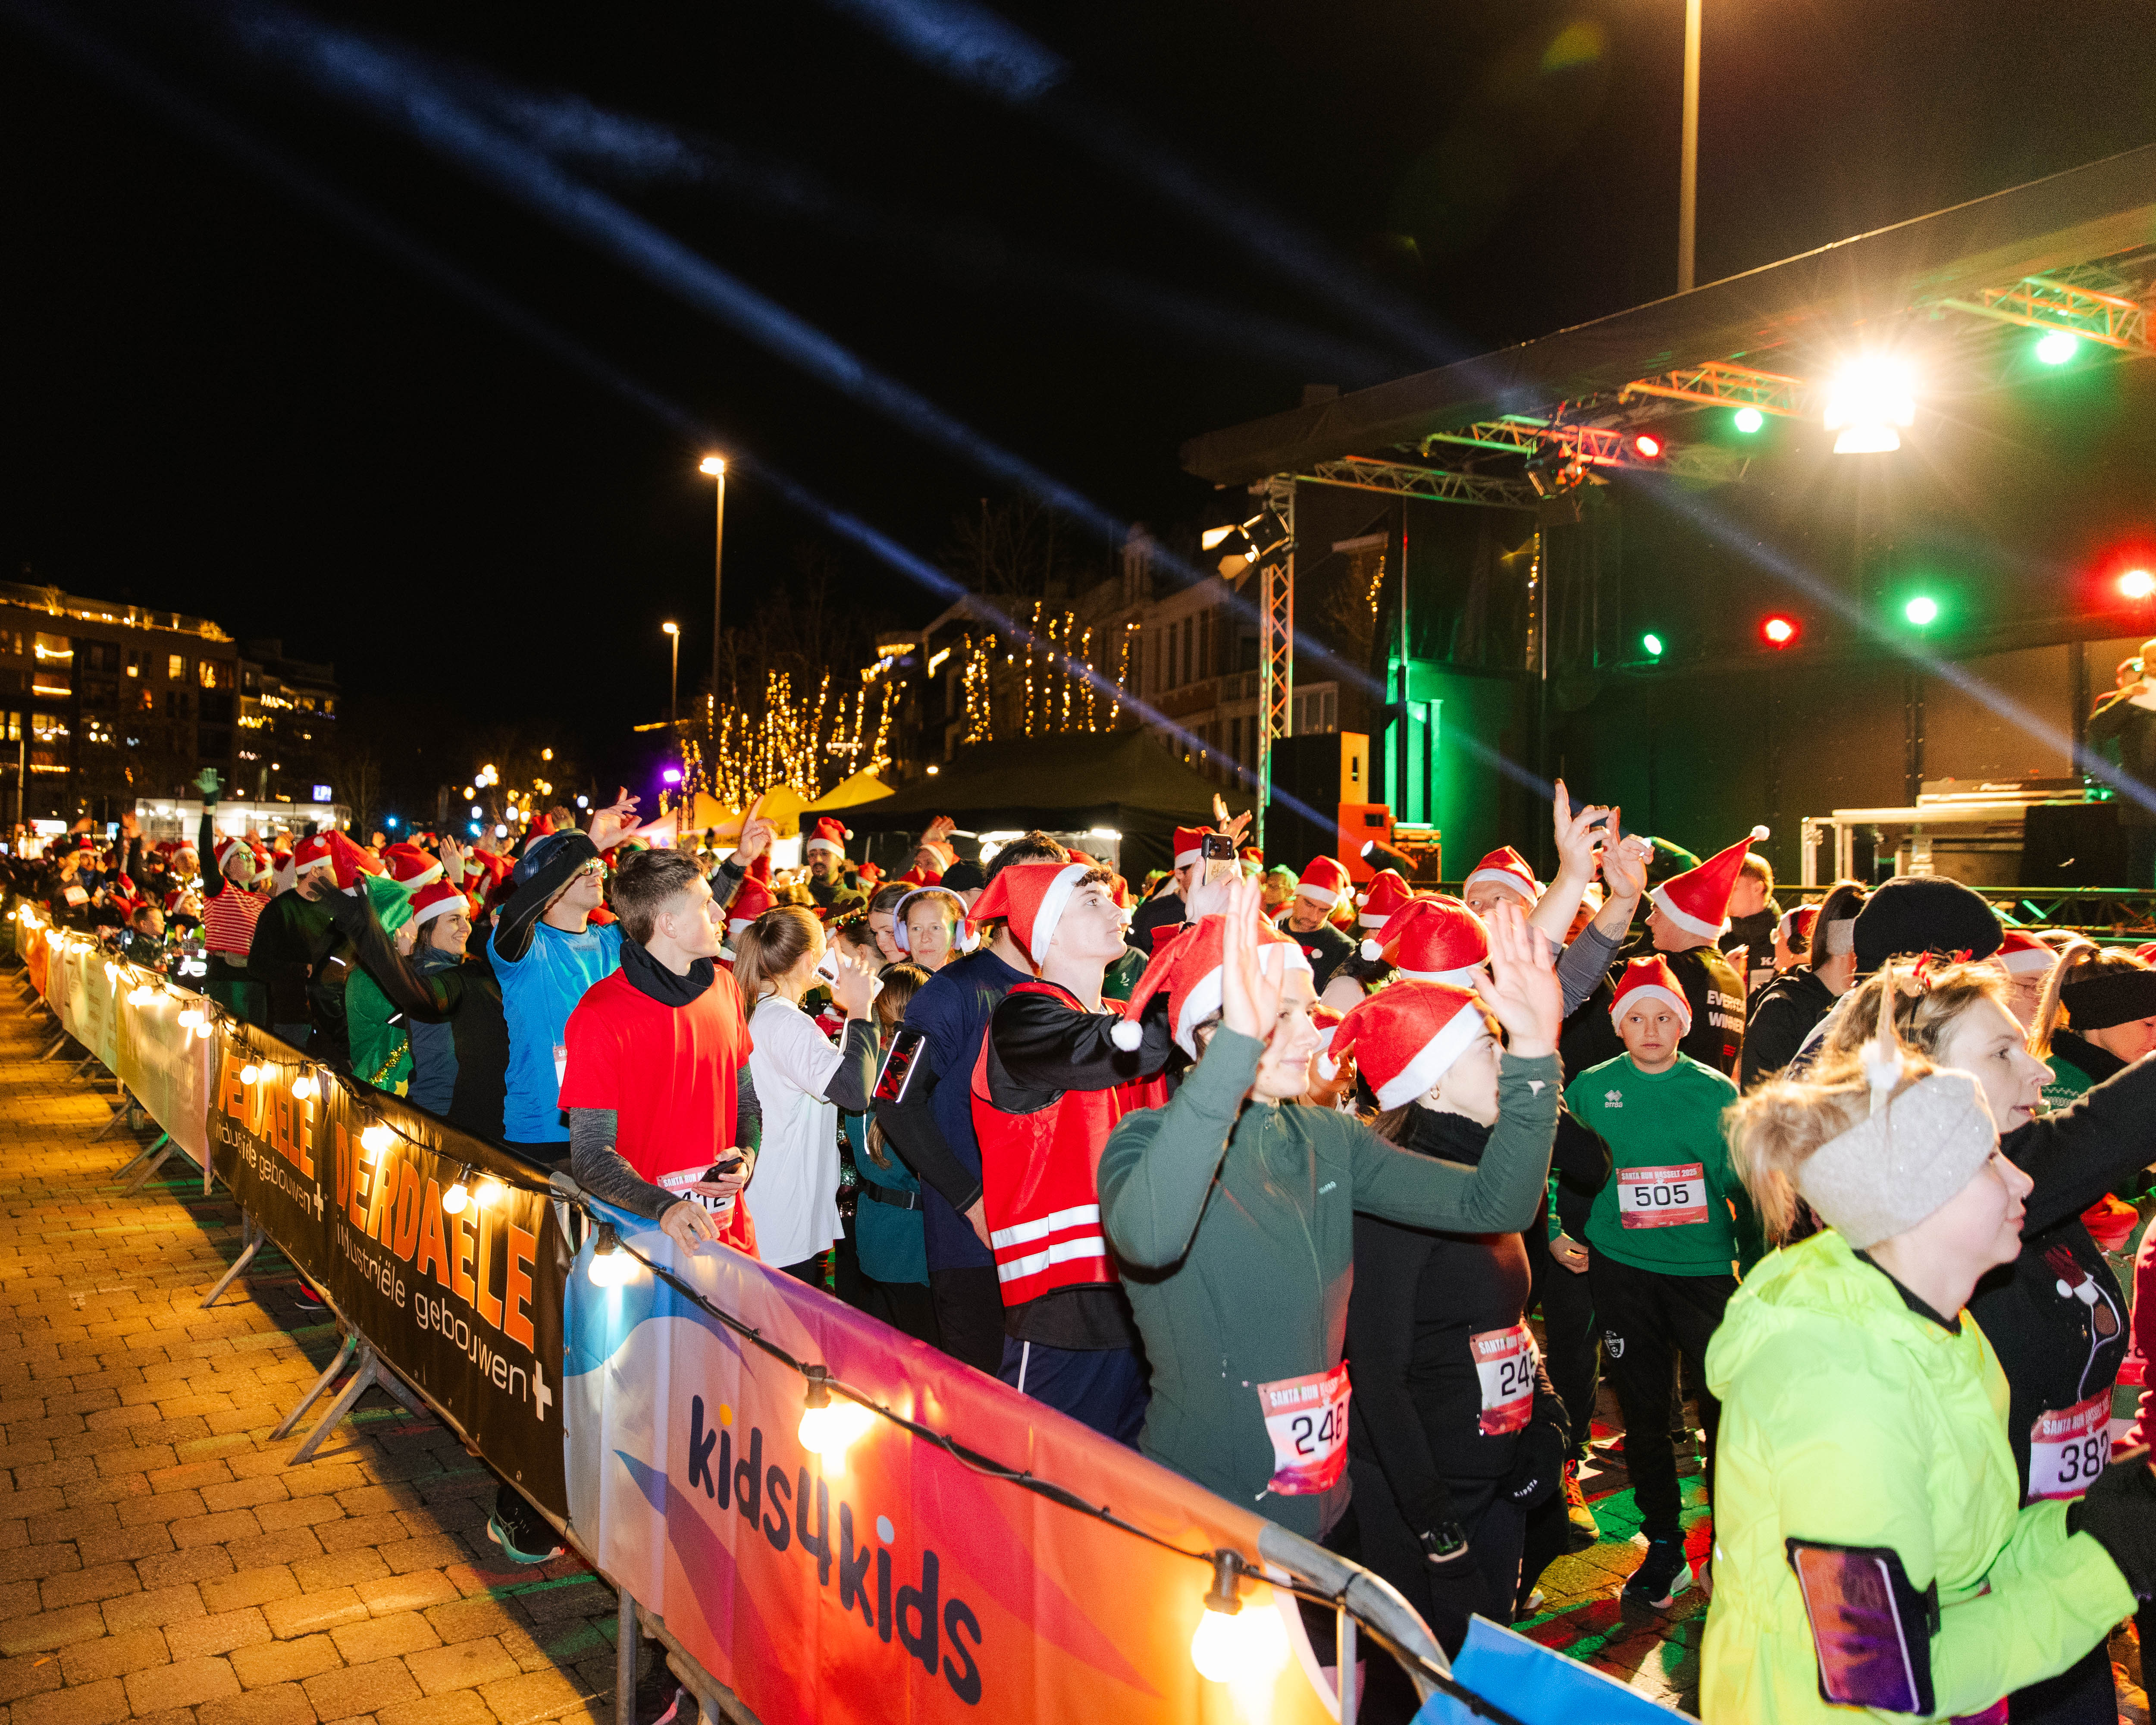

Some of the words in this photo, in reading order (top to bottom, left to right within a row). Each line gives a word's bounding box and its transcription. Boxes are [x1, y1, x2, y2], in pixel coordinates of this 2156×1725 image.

[259, 1155, 310, 1214] gebouwen
[663, 1176, 684, 1187] SANTA
[684, 1173, 697, 1183] RUN
[1640, 1171, 1653, 1179] RUN
[1655, 1170, 1680, 1179] HASSELT
[1682, 1168, 1697, 1177] 2025
[1635, 1184, 1689, 1206] 505
[415, 1292, 526, 1402] gebouwen
[1478, 1338, 1505, 1355] SANTA
[1270, 1387, 1300, 1407] SANTA
[1301, 1384, 1319, 1401] RUN
[1291, 1402, 1344, 1455] 246
[2043, 1418, 2071, 1435] SANTA
[1514, 1479, 1538, 1497] KIPSTA
[688, 1394, 983, 1705] kids4kids
